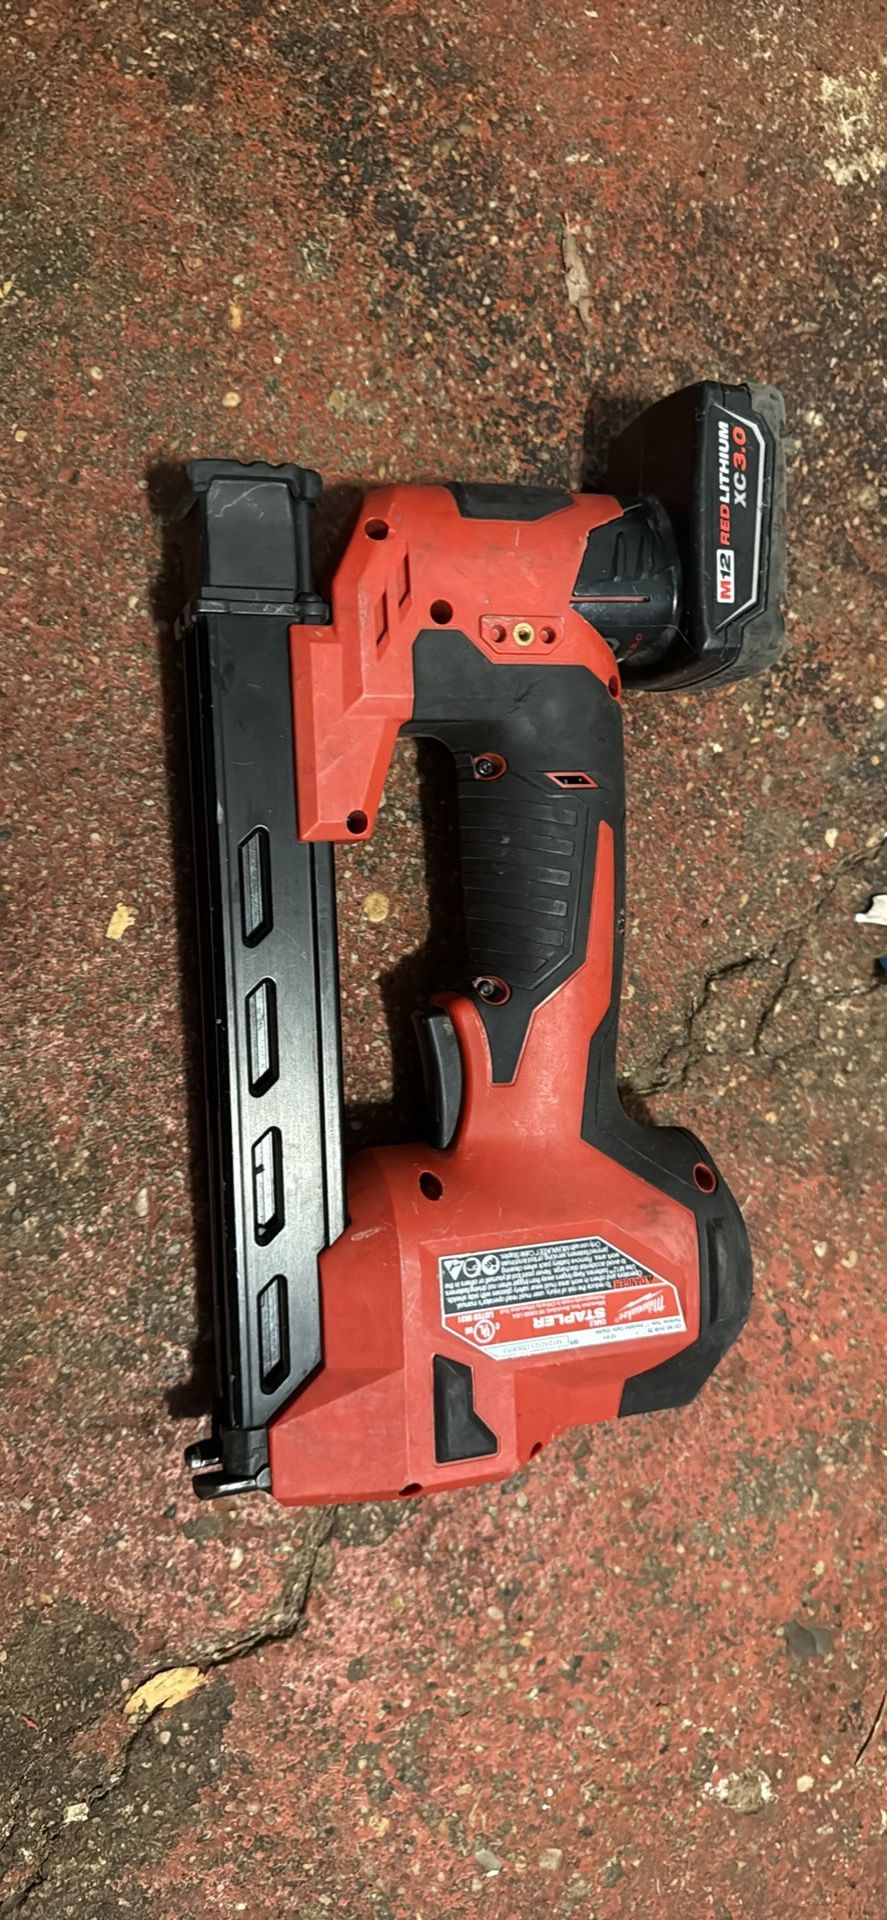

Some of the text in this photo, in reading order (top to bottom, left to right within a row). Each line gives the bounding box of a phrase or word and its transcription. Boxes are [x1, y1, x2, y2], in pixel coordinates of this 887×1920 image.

[718, 421, 732, 600] M12 REDLITHIUM
[532, 1307, 606, 1329] STAPLER
